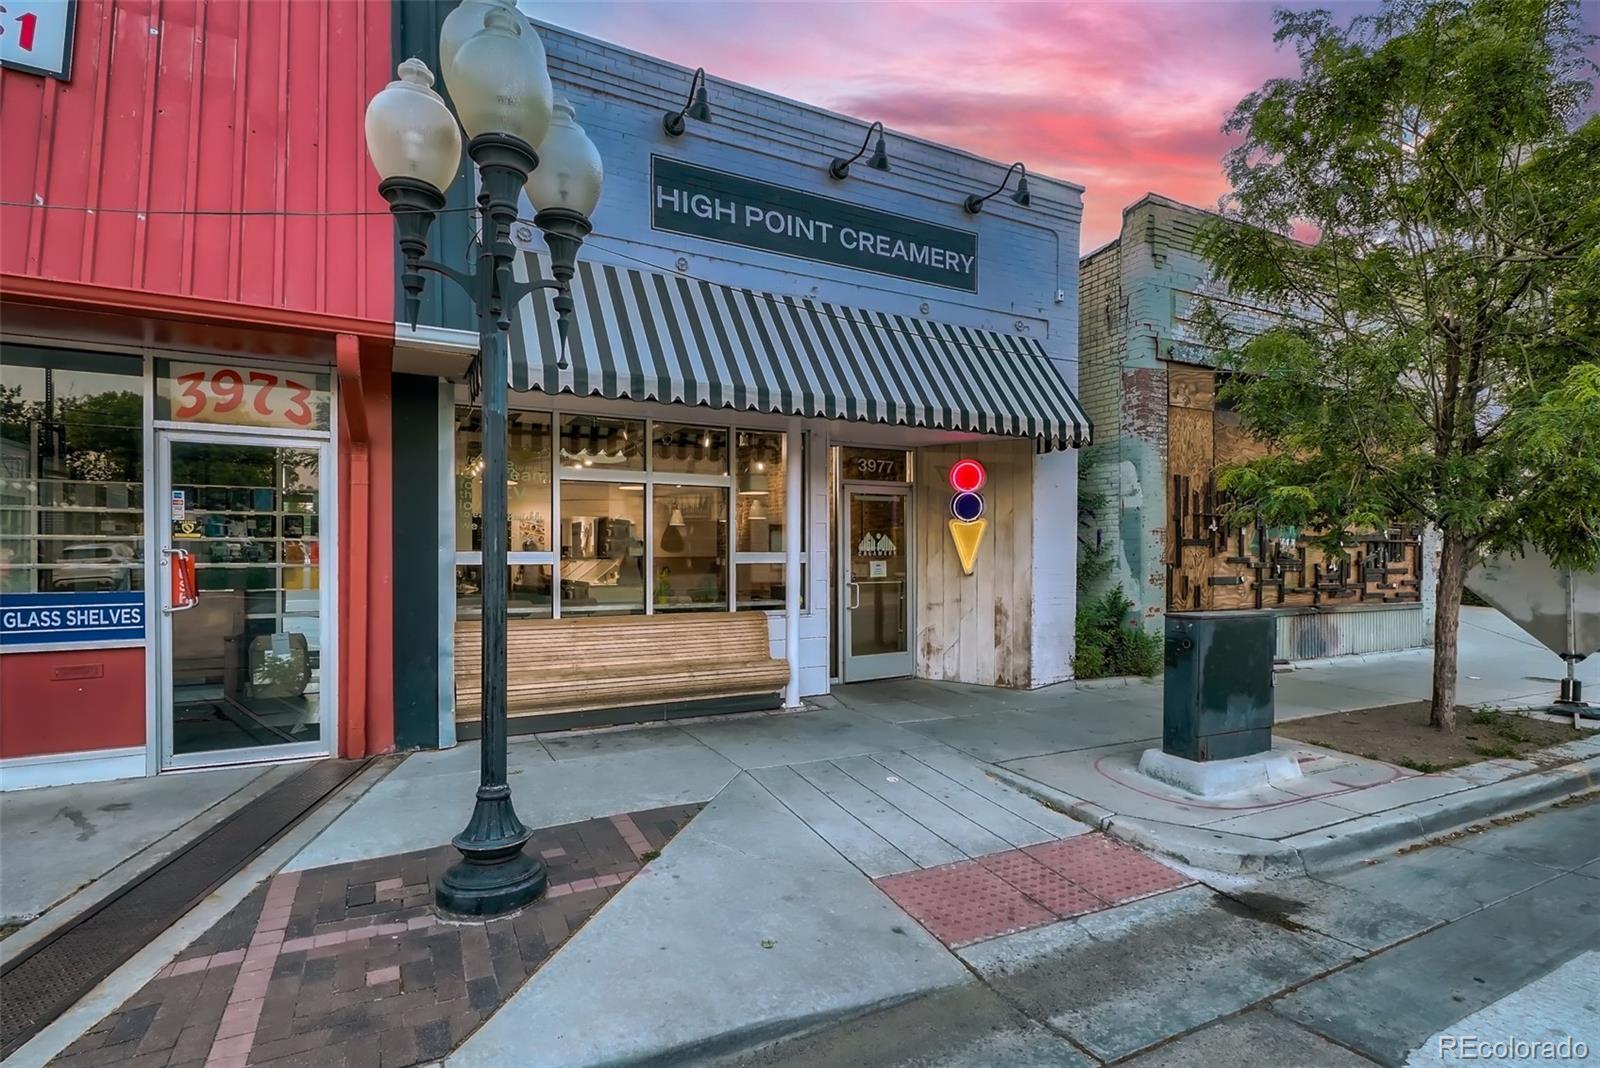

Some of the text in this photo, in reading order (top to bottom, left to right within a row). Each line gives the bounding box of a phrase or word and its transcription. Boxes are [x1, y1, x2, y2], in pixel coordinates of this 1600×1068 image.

[657, 185, 975, 275] HIGH POINT CREAMERY
[175, 368, 313, 426] 3973
[858, 458, 895, 473] 3977
[3, 608, 141, 628] GLASS SHELVES
